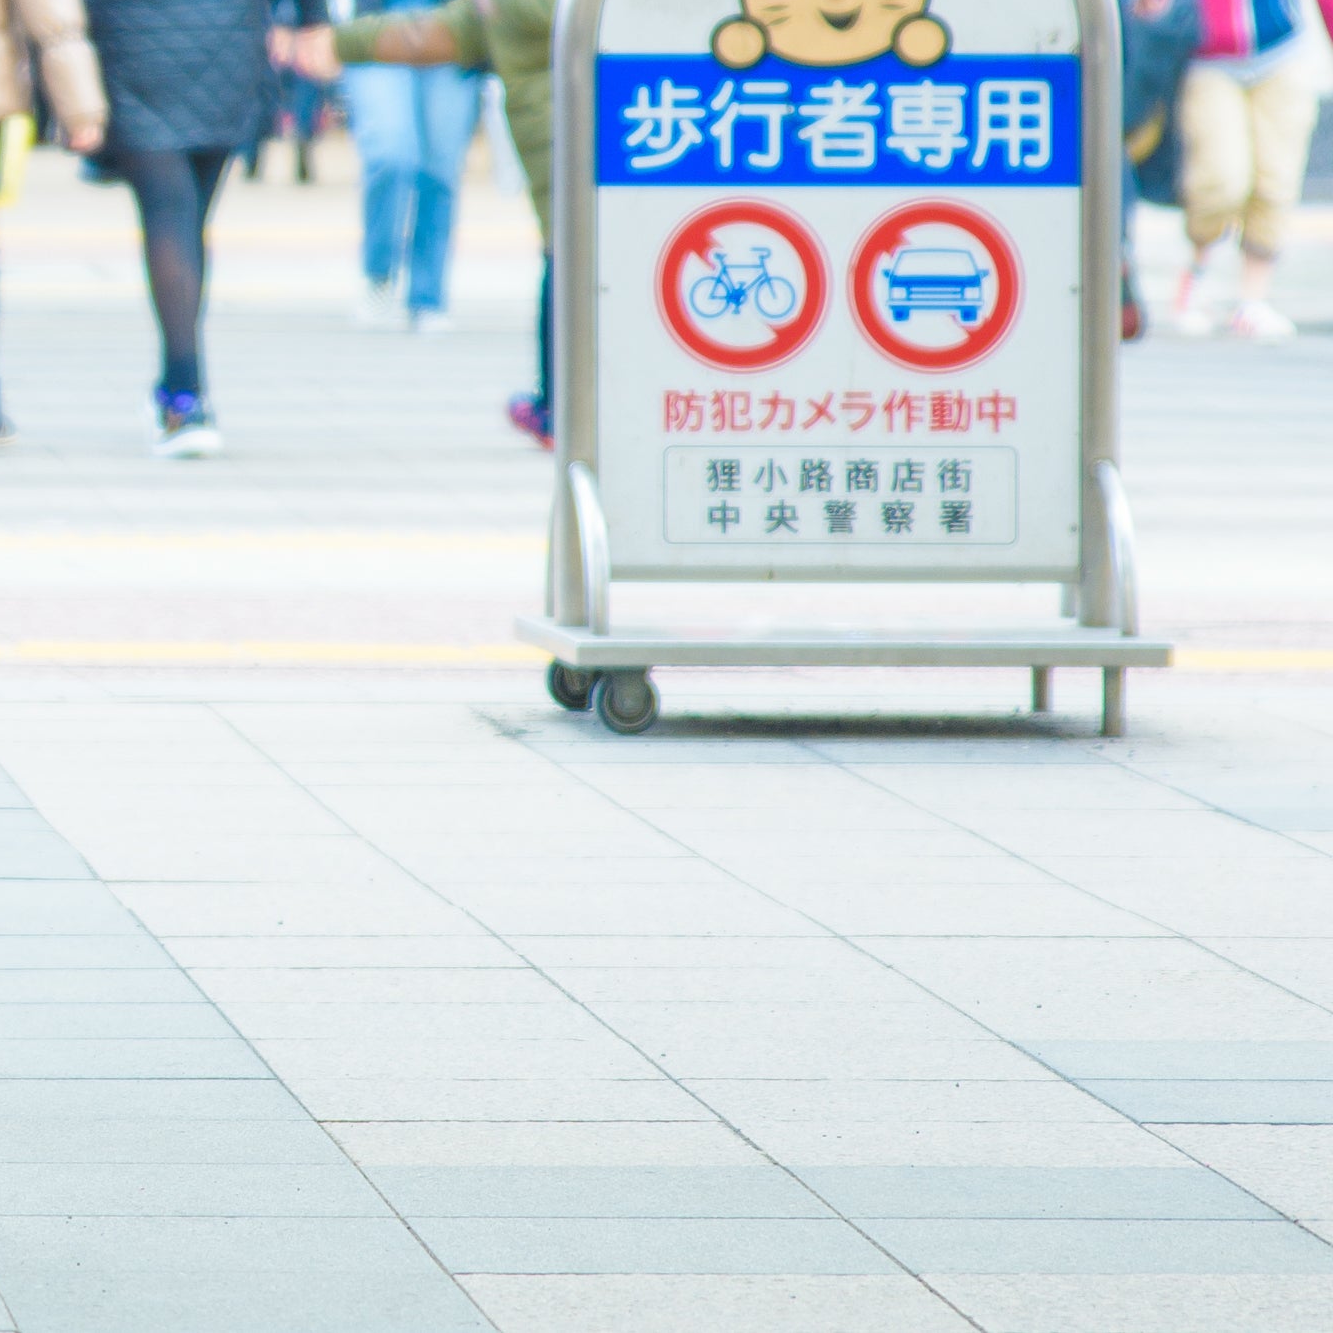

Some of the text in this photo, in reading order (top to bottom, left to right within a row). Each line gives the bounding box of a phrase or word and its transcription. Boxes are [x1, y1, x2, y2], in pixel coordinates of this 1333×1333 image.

[624, 79, 1052, 168] 歩行者専用
[662, 389, 1018, 434] 防犯カメラ作動中
[706, 457, 972, 494] 狸小路商店街
[707, 499, 974, 535] 中央警察署
